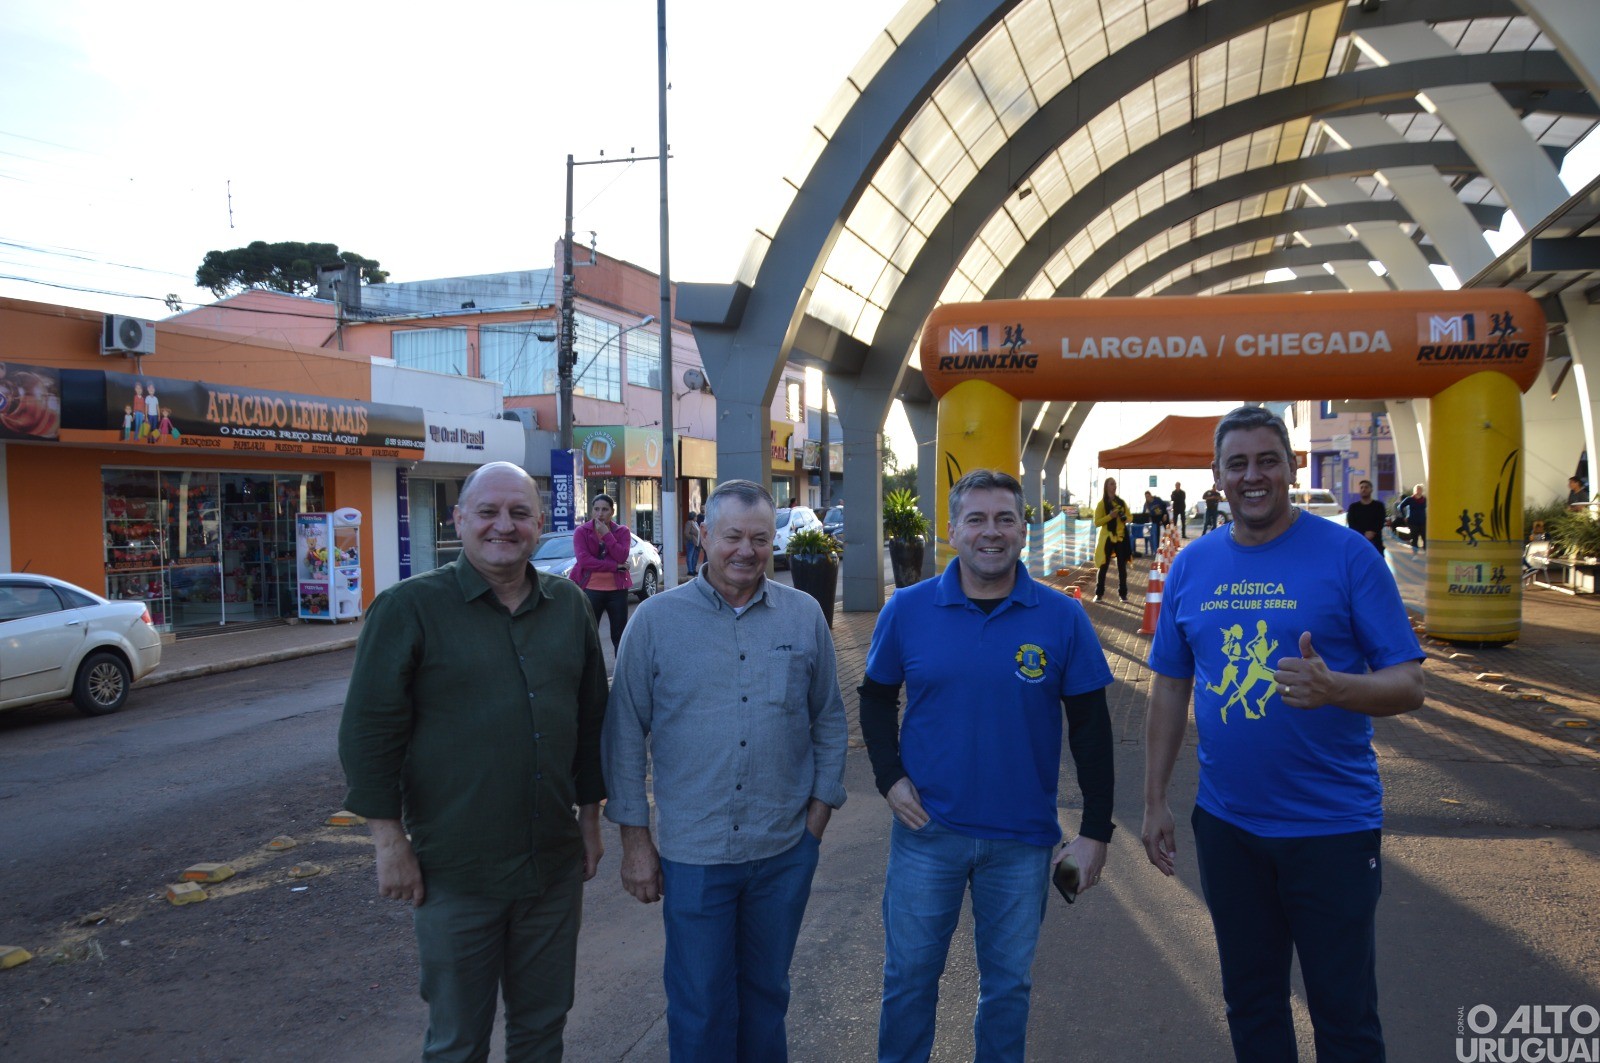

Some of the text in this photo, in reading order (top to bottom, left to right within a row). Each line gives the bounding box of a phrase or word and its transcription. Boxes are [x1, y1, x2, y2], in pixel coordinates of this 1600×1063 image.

[1430, 313, 1475, 342] M1
[949, 325, 989, 354] M1
[1061, 330, 1392, 359] LARGADA / CHEGADA
[1416, 342, 1531, 361] RUNNING
[939, 353, 1039, 371] RUNNING
[206, 390, 368, 436] ATACADO LEVE MAIS
[220, 426, 359, 445] O MENOR PREÇO ESTÁ AQUI!
[441, 426, 485, 445] Oral Brasil
[233, 440, 265, 451] PAPELARIA
[554, 474, 568, 516] Brasil
[1230, 579, 1285, 596] RÚSTICA
[1448, 584, 1512, 595] RUNNING
[1200, 599, 1297, 612] LIONS CLUBE SEBERI
